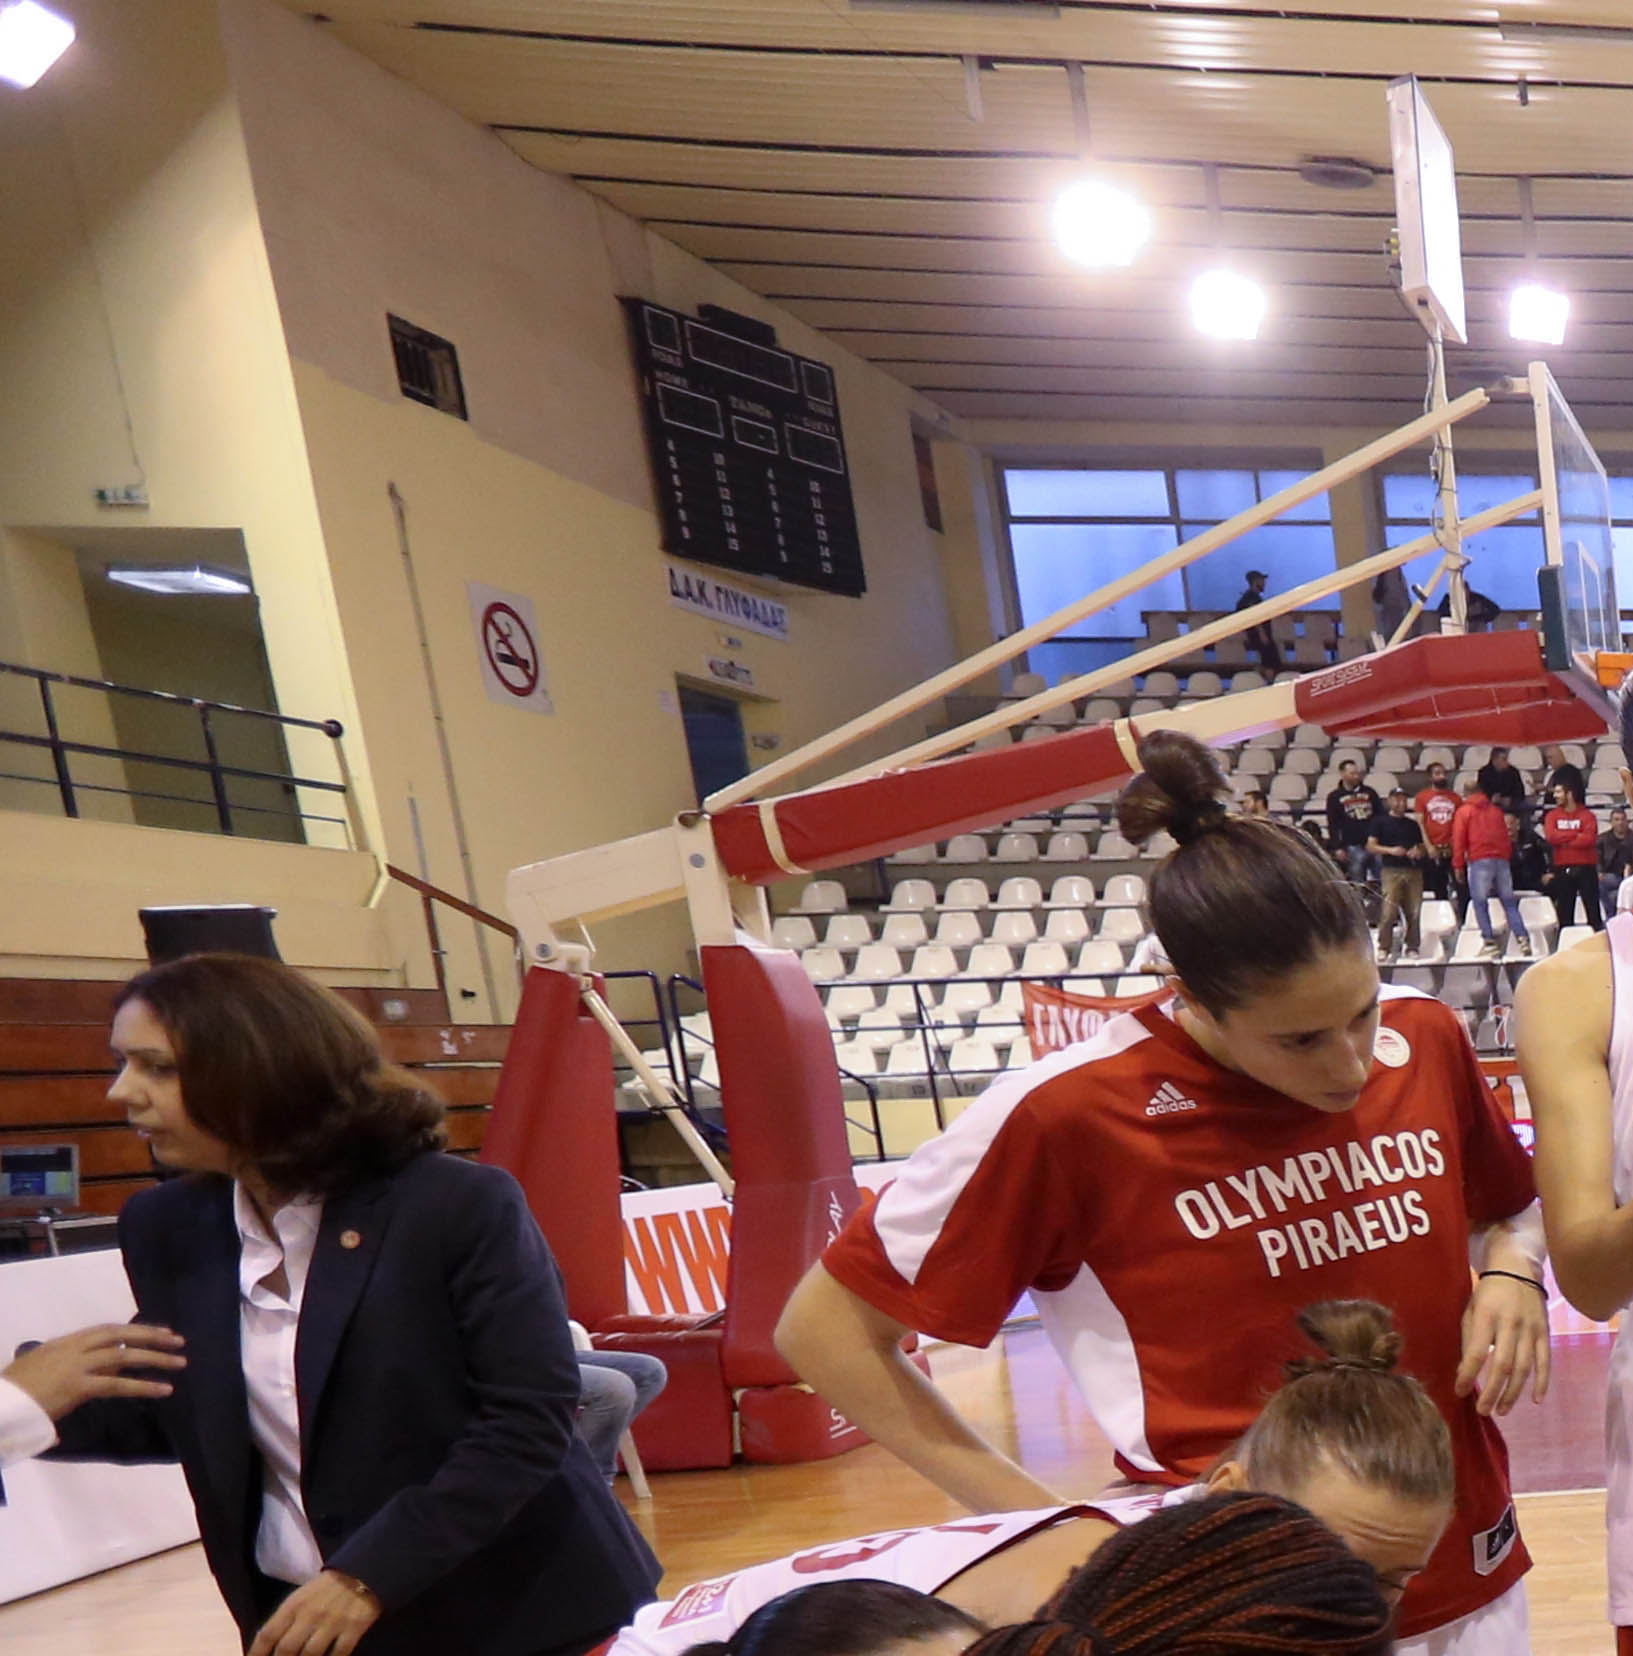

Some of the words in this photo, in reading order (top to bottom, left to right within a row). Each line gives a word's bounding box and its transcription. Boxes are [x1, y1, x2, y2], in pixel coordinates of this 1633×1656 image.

[1145, 1099, 1197, 1116] adidas
[1174, 1129, 1445, 1240] OLYMPIACOS
[1257, 1189, 1431, 1277] PIRAEUS
